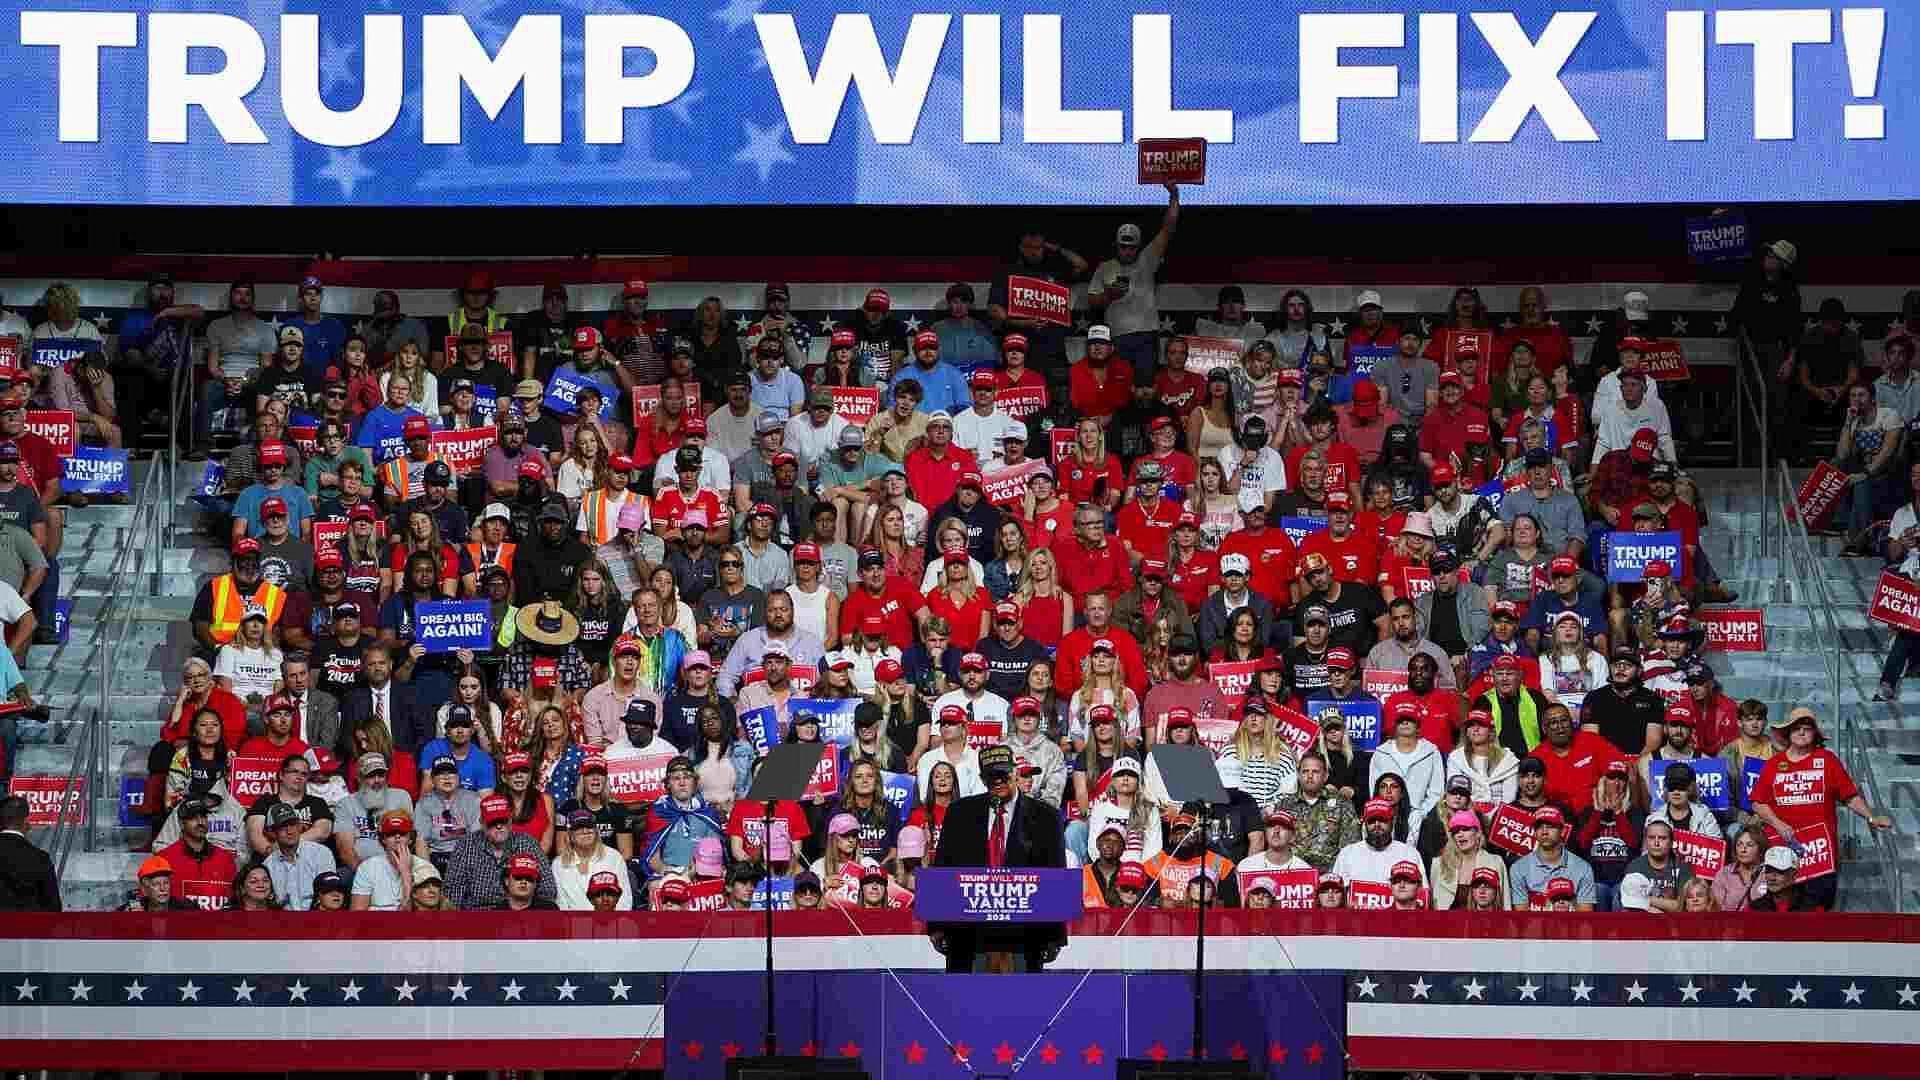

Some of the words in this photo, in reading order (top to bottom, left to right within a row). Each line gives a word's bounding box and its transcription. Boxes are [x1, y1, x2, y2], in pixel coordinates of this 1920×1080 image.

[20, 12, 696, 147] TRUMP
[754, 13, 1234, 145] WILL
[1299, 12, 1601, 145] FIX
[1666, 7, 1887, 142] IT!
[1143, 150, 1201, 163] TRUMP
[1691, 225, 1746, 242] TRUMP
[1013, 287, 1066, 307] TRUMP
[39, 349, 86, 363] TRUM
[435, 437, 495, 455] TRUMP
[66, 458, 123, 474] TRUMP
[66, 471, 92, 482] WILL
[94, 472, 110, 483] FIX
[111, 473, 123, 483] IT
[1613, 546, 1678, 561] TRUMP
[1615, 559, 1643, 569] WILL
[1881, 584, 1919, 602] DREAM
[1878, 597, 1920, 617] AGAI
[419, 613, 461, 626] DREAM
[463, 612, 488, 625] BIG,
[422, 623, 483, 639] AGAIN!
[1727, 632, 1745, 643] FIX
[1747, 632, 1758, 642] IT
[239, 665, 275, 675] TRUMP
[991, 661, 1029, 671] TRUMP
[327, 669, 355, 683] 2024
[1214, 672, 1253, 688] TRU
[754, 714, 770, 758] TRU
[235, 771, 277, 782] DREAM
[236, 781, 278, 796] AGAI
[960, 875, 988, 883] TRUMP
[991, 875, 1012, 883] WILL
[1014, 875, 1028, 883] FIX
[1029, 875, 1039, 883] IT
[960, 883, 1039, 897] TRUMP
[969, 897, 1029, 909] VANCE
[1355, 892, 1395, 908] TRU
[987, 912, 1010, 921] 2024
